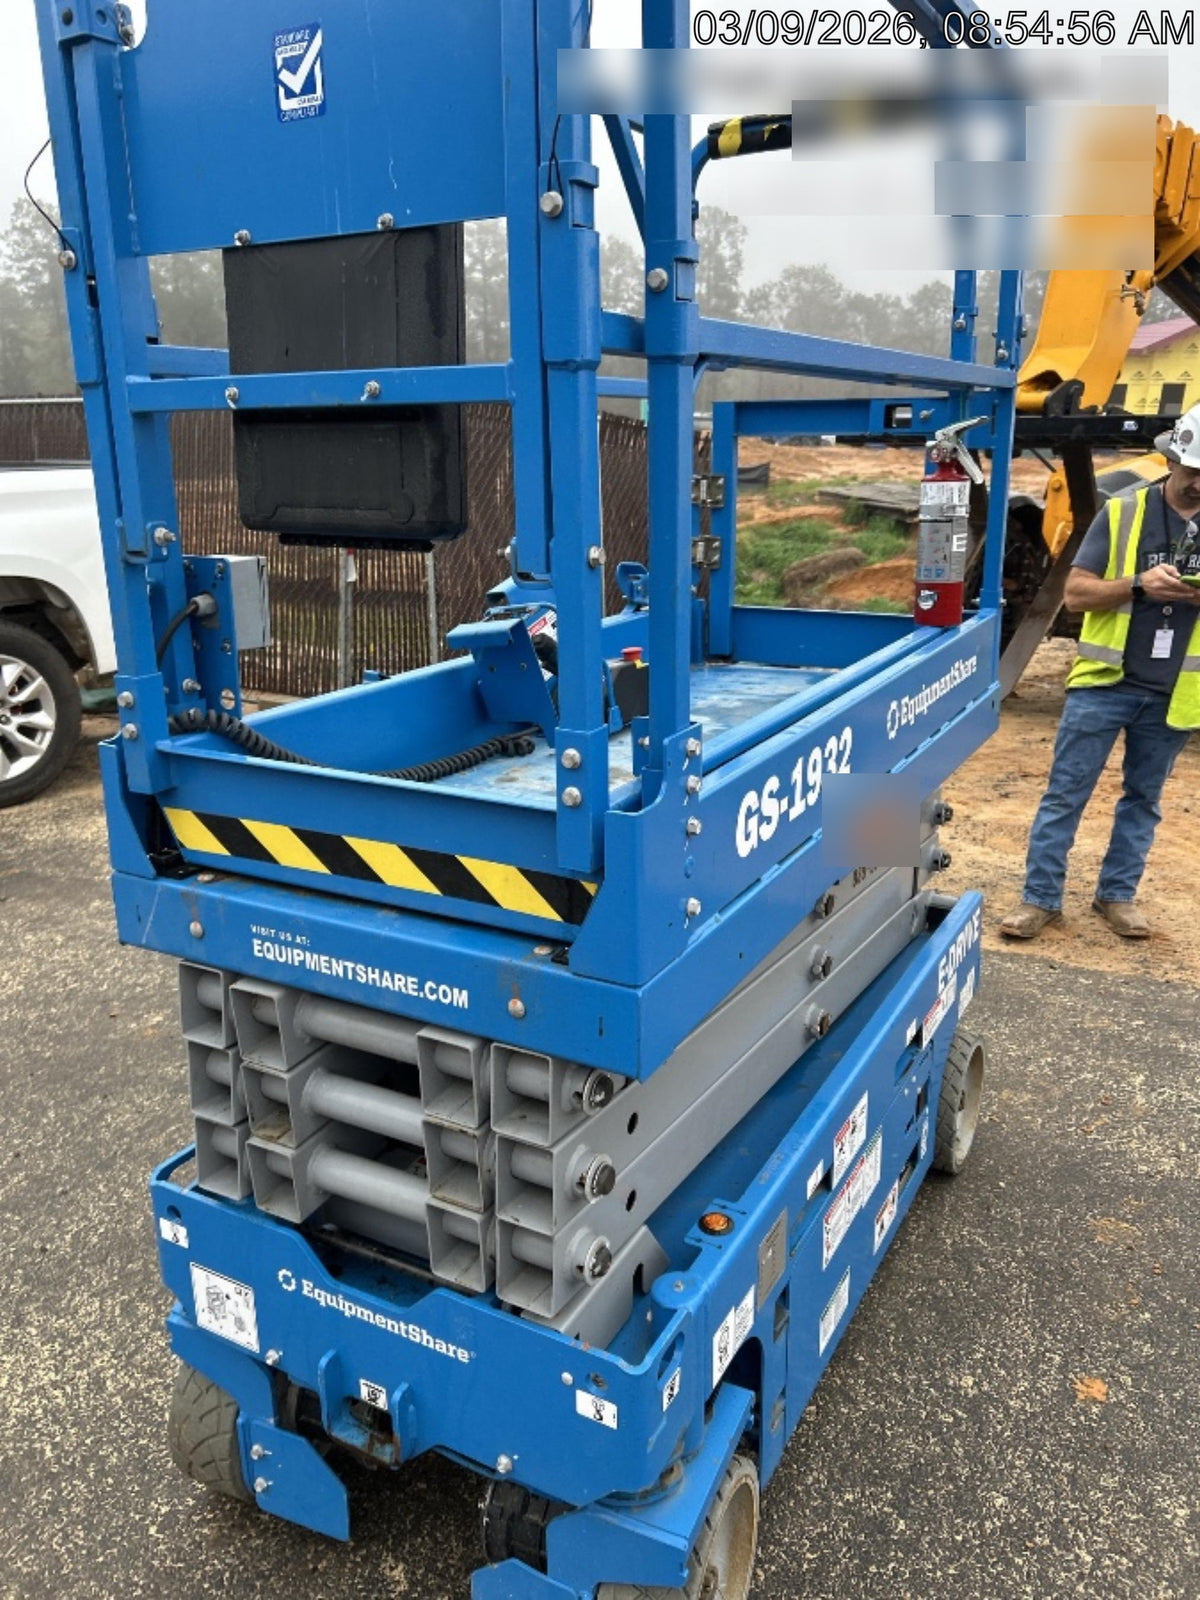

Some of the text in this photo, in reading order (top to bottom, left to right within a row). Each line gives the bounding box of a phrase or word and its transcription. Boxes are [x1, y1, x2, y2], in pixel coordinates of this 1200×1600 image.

[900, 655, 977, 727] EquipmentShare
[735, 726, 853, 858] GS-1932
[250, 924, 311, 947] VISIT US AT:
[252, 938, 469, 1009] EQUIPMENTSHARE.COM
[301, 1279, 471, 1364] EquipmentShare
